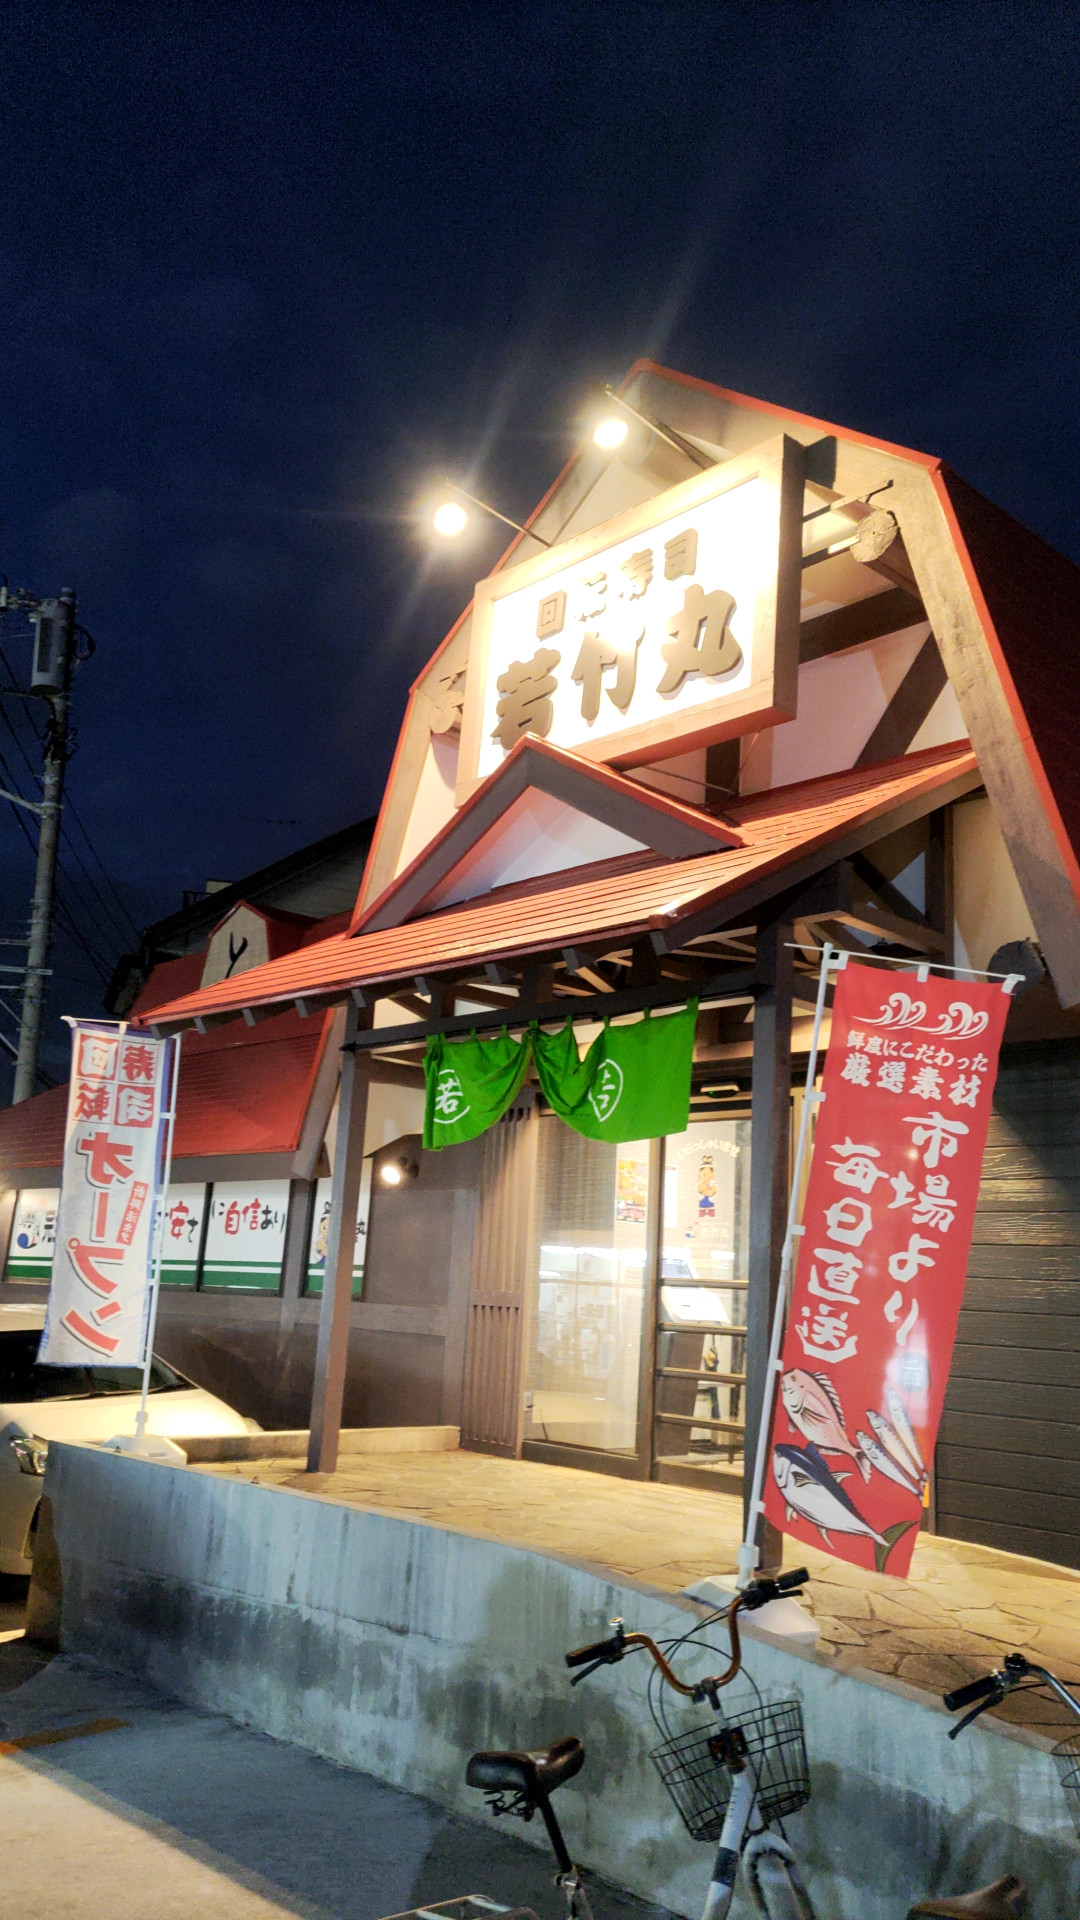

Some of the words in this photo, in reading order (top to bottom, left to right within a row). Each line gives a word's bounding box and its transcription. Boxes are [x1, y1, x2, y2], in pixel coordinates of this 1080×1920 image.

[490, 584, 744, 751] 若竹丸
[846, 1029, 988, 1072] 鮮度にこだわった
[435, 1078, 464, 1114] 若
[840, 1052, 981, 1108] 厳選素材
[211, 1197, 286, 1236] に自信あり
[883, 1111, 970, 1346] 市場より
[795, 1136, 889, 1363] 毎日直送
